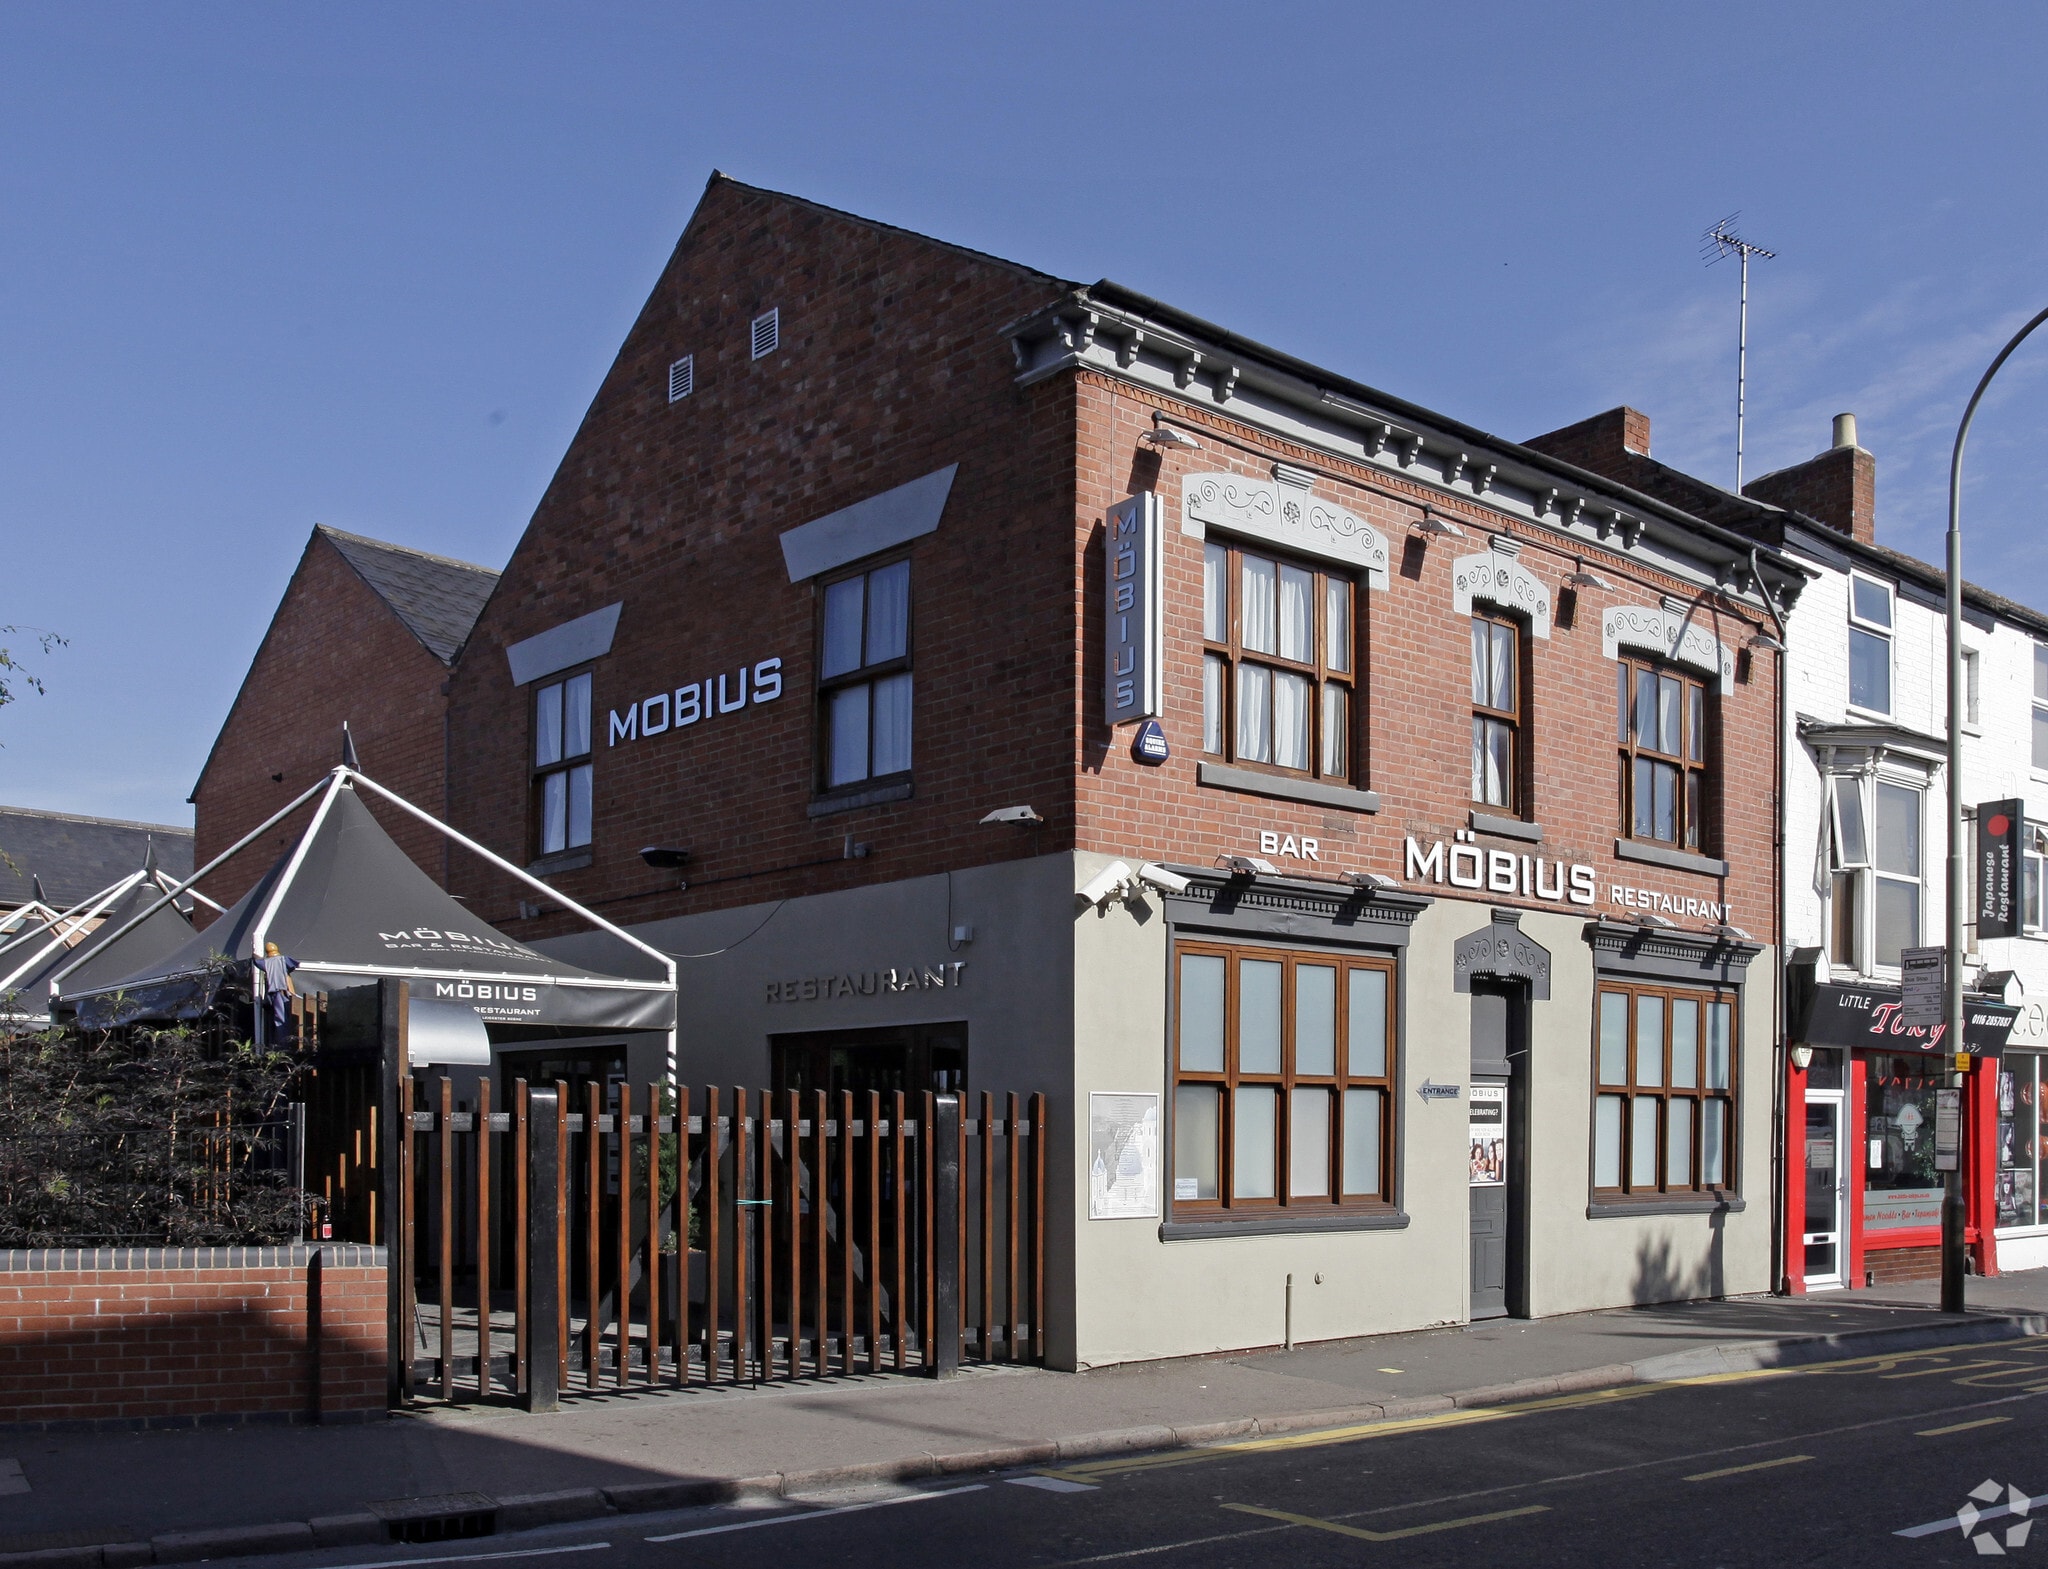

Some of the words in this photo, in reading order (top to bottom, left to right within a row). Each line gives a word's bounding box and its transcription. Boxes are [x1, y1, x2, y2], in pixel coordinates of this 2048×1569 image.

[1113, 507, 1137, 709] MÖBIUS
[609, 657, 782, 747] MOBIUS
[1260, 831, 1319, 861] BAR
[1406, 829, 1596, 905] MÖBIUS
[1983, 851, 1995, 918] Japanese
[1998, 844, 2009, 922] Restaurant
[1611, 885, 1732, 921] RESTAURANT
[378, 928, 538, 957] MÖBIUS
[436, 980, 537, 1001] MÖBIUS
[765, 960, 967, 1003] RESTAURANT
[1972, 1013, 1987, 1025] 0116
[1470, 1089, 1499, 1097] ÖBIUS
[1470, 1108, 1499, 1116] ELEBRATING?
